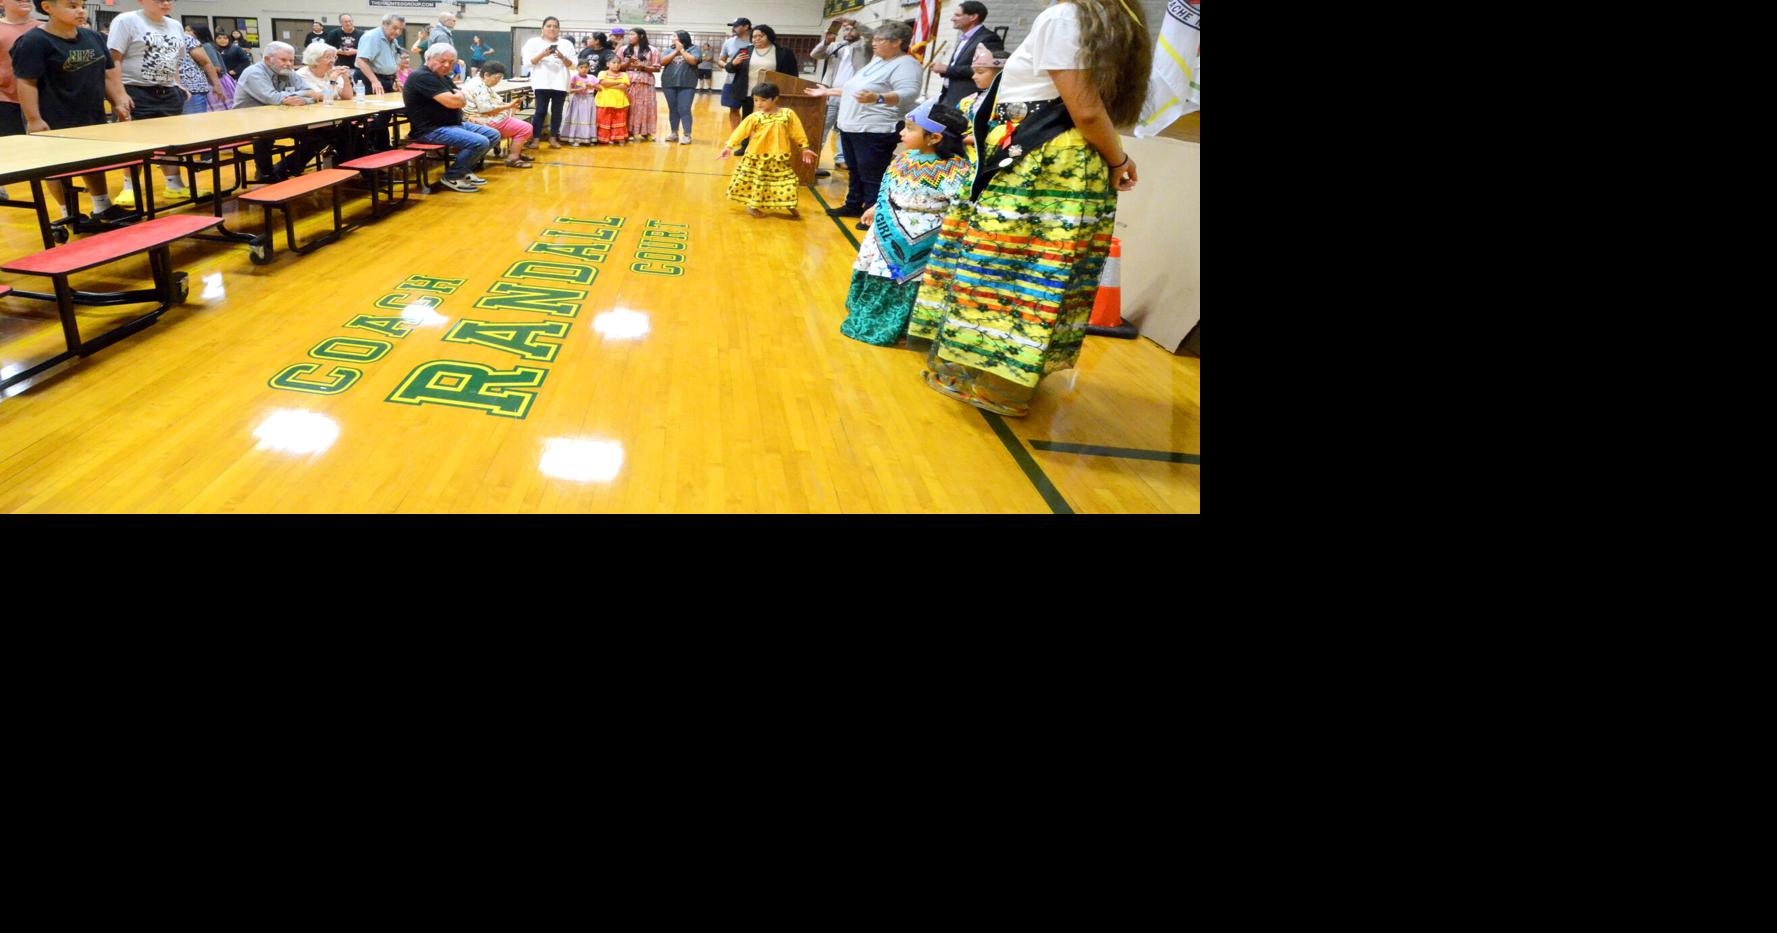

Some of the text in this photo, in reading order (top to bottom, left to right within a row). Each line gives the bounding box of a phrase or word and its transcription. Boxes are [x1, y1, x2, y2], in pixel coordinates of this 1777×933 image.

[69, 49, 96, 61] NIKE
[630, 217, 690, 277] COURT
[875, 212, 893, 242] GIRL
[267, 273, 468, 395] COACH
[384, 216, 627, 420] RANDALL
